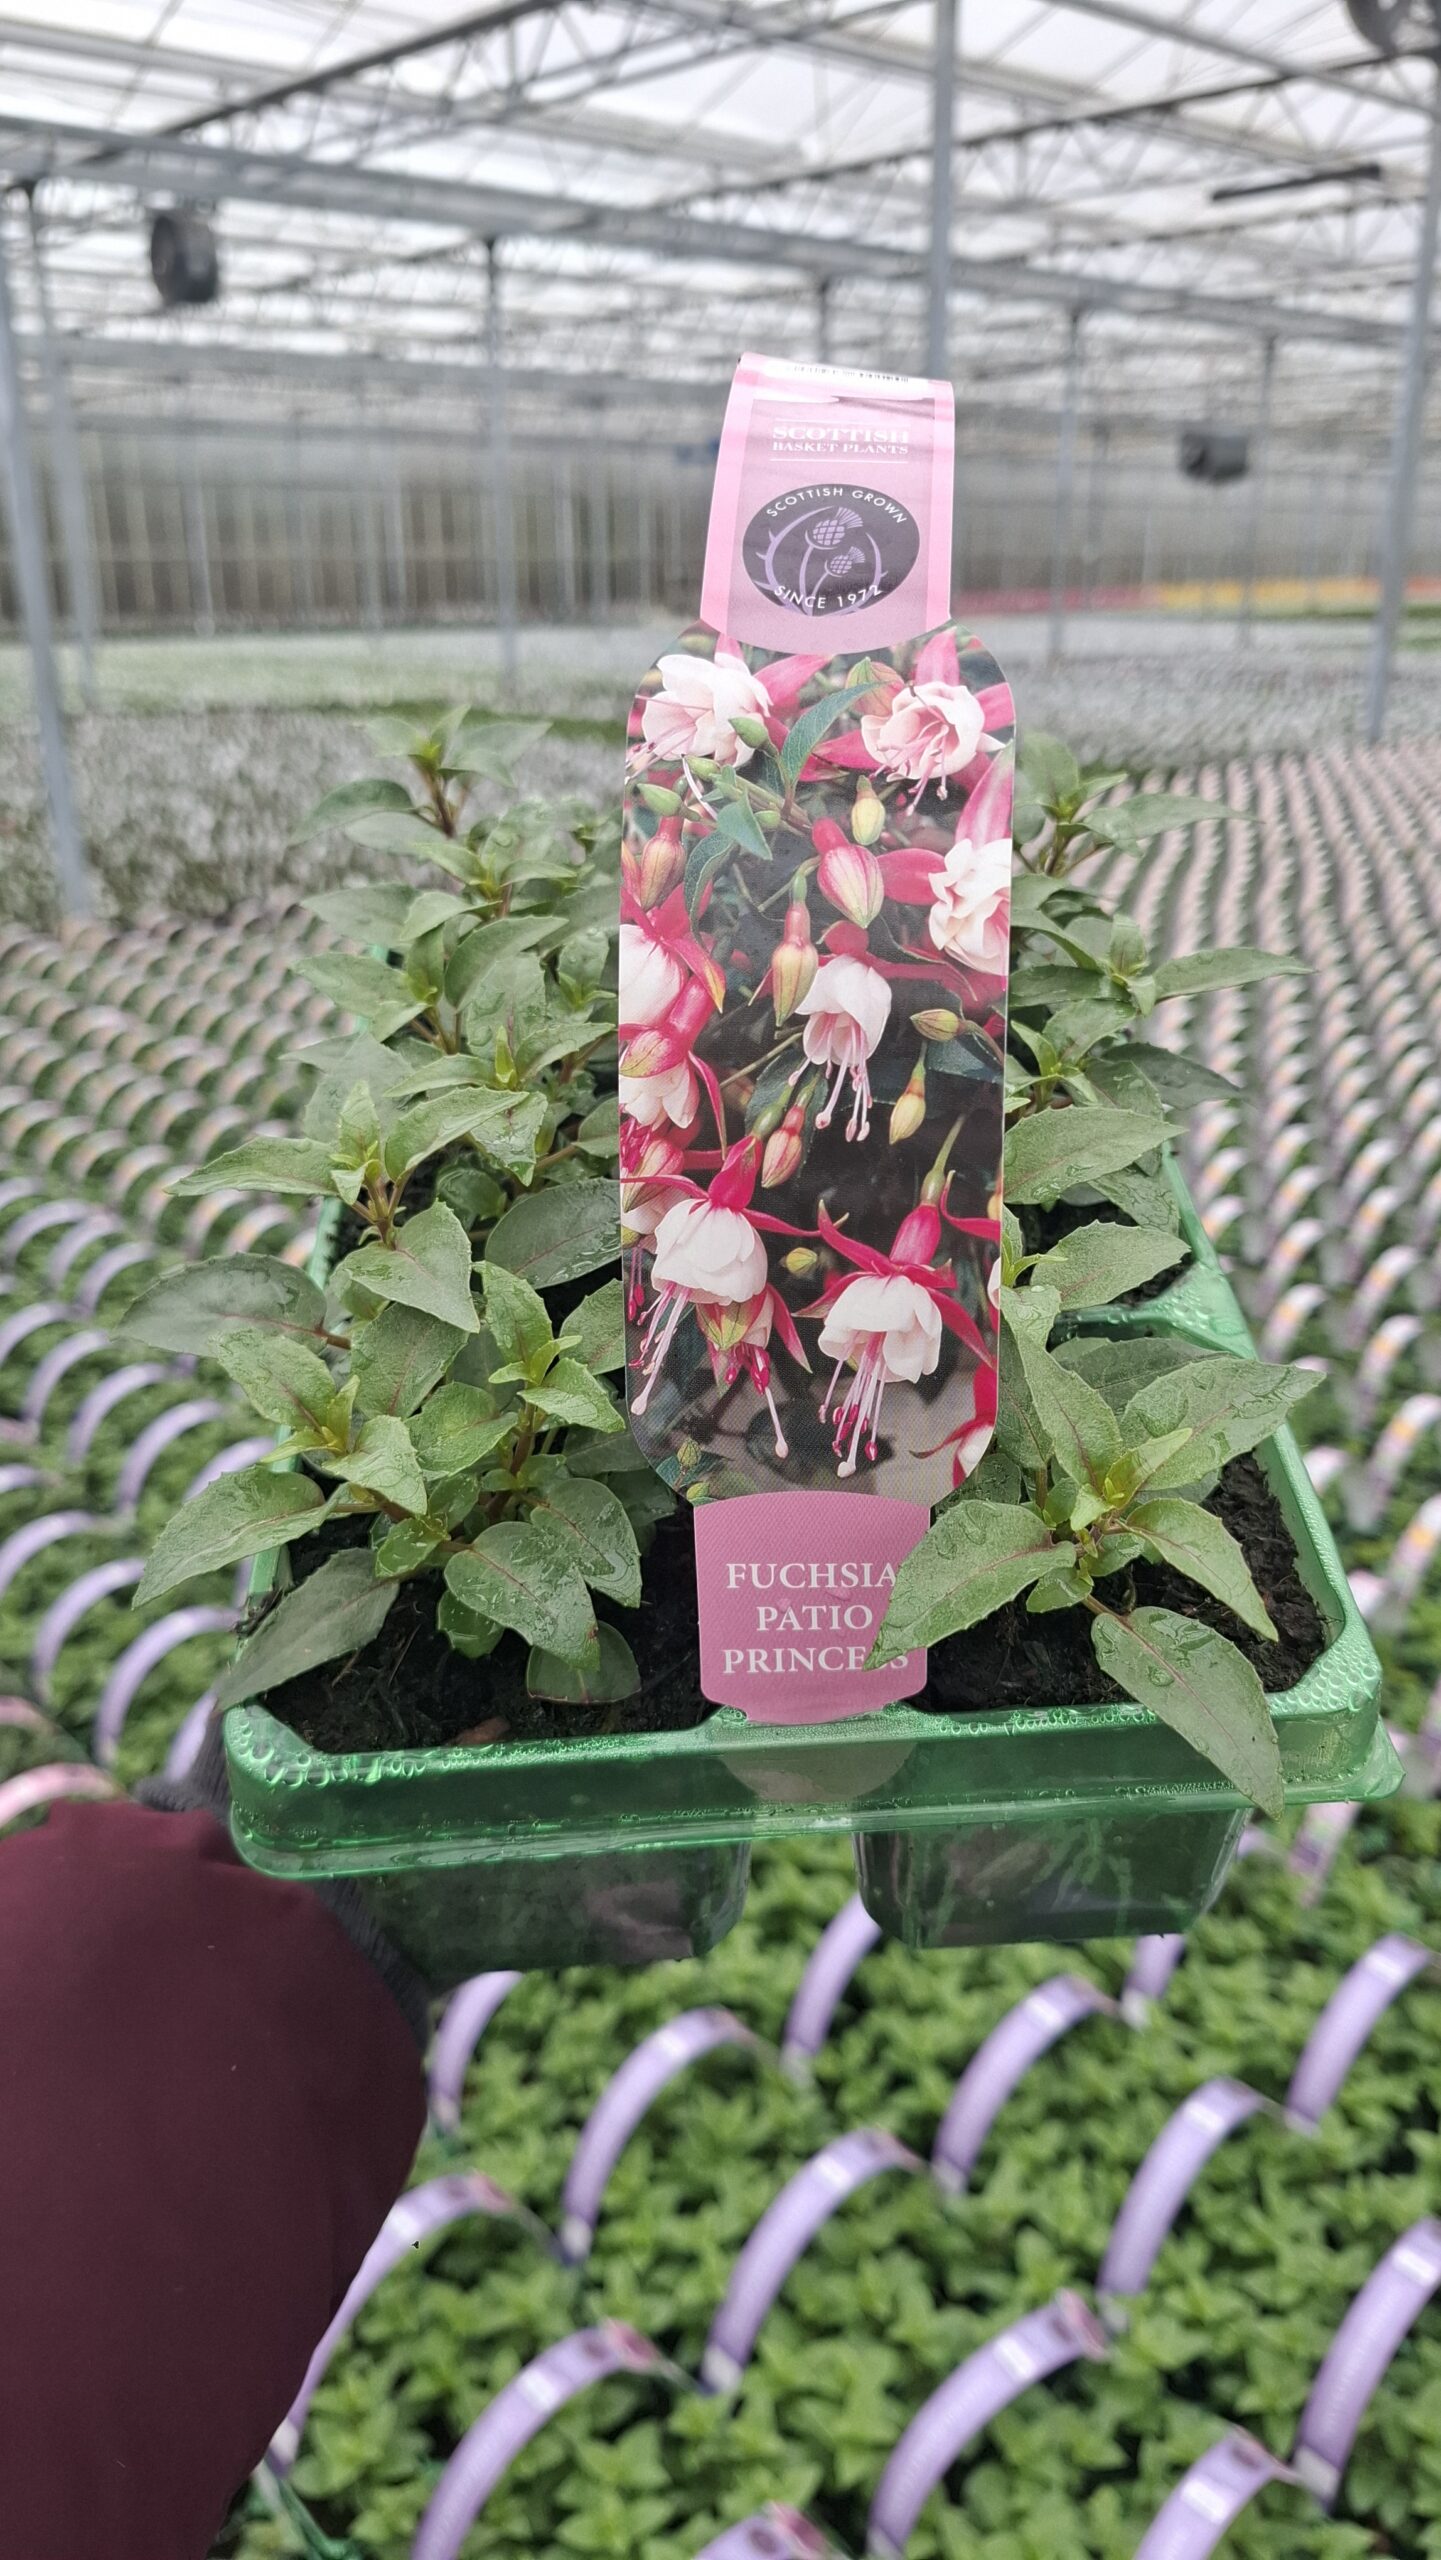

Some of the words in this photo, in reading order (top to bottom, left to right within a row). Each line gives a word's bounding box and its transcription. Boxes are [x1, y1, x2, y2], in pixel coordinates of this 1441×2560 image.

[772, 426, 909, 444] SCOTTISH
[772, 442, 839, 453] BASKET
[843, 443, 909, 455] PLANTS
[767, 487, 843, 517] SCOTTISH
[852, 489, 907, 523] GROWN
[774, 585, 826, 609] SINCE
[837, 584, 883, 607] 1972
[726, 1562, 896, 1588] FUCHSIA
[756, 1604, 873, 1631] PATIO
[723, 1646, 908, 1674] PRINCES
